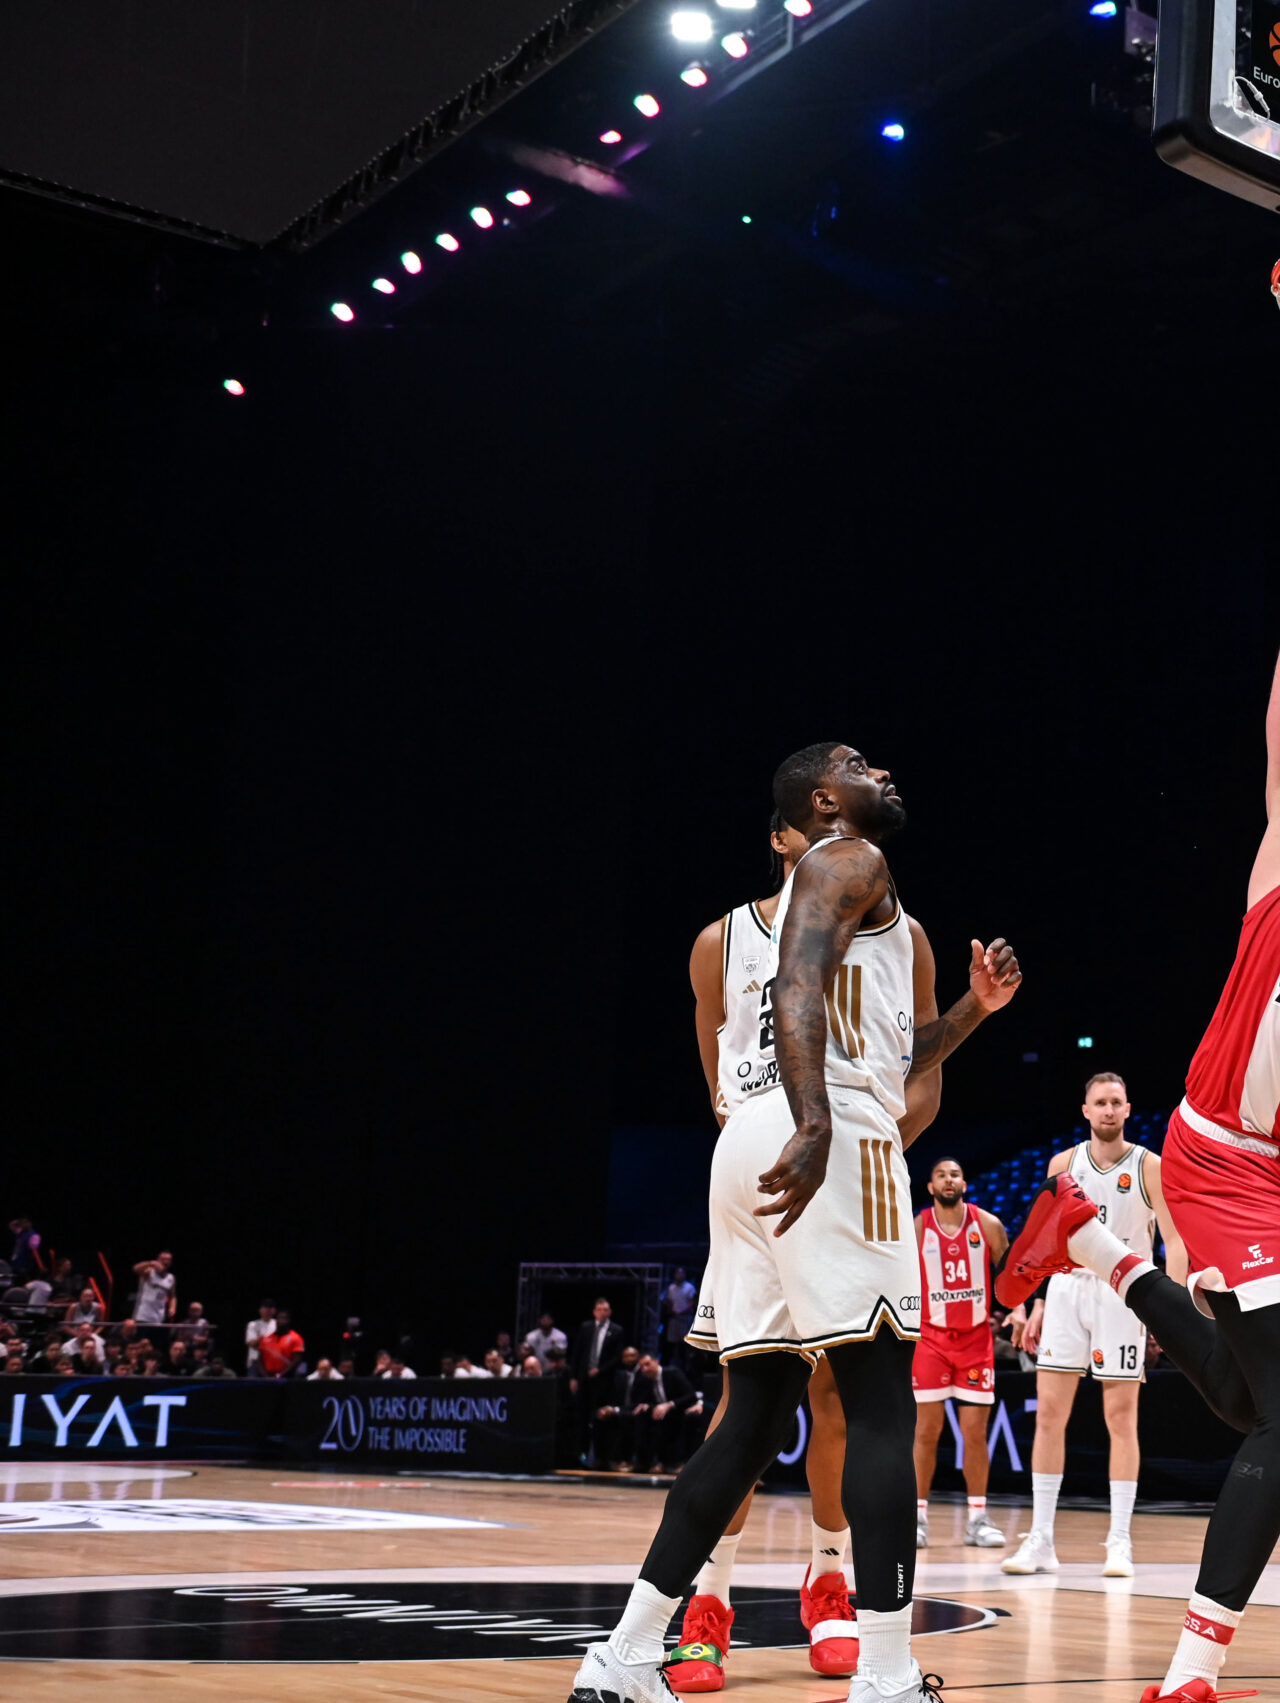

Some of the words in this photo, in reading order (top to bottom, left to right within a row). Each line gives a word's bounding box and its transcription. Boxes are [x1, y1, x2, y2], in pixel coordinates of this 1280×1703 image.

[944, 1259, 968, 1283] 34
[1241, 1256, 1274, 1270] FlexCar
[1119, 1344, 1137, 1370] 13
[8, 1393, 187, 1447] IYAT
[368, 1396, 406, 1420] YEARS
[409, 1396, 428, 1421] OF
[431, 1396, 507, 1422] IMAGINING
[319, 1395, 365, 1451] 20
[368, 1426, 391, 1450] THE
[394, 1428, 468, 1453] IMPOSSIBLE
